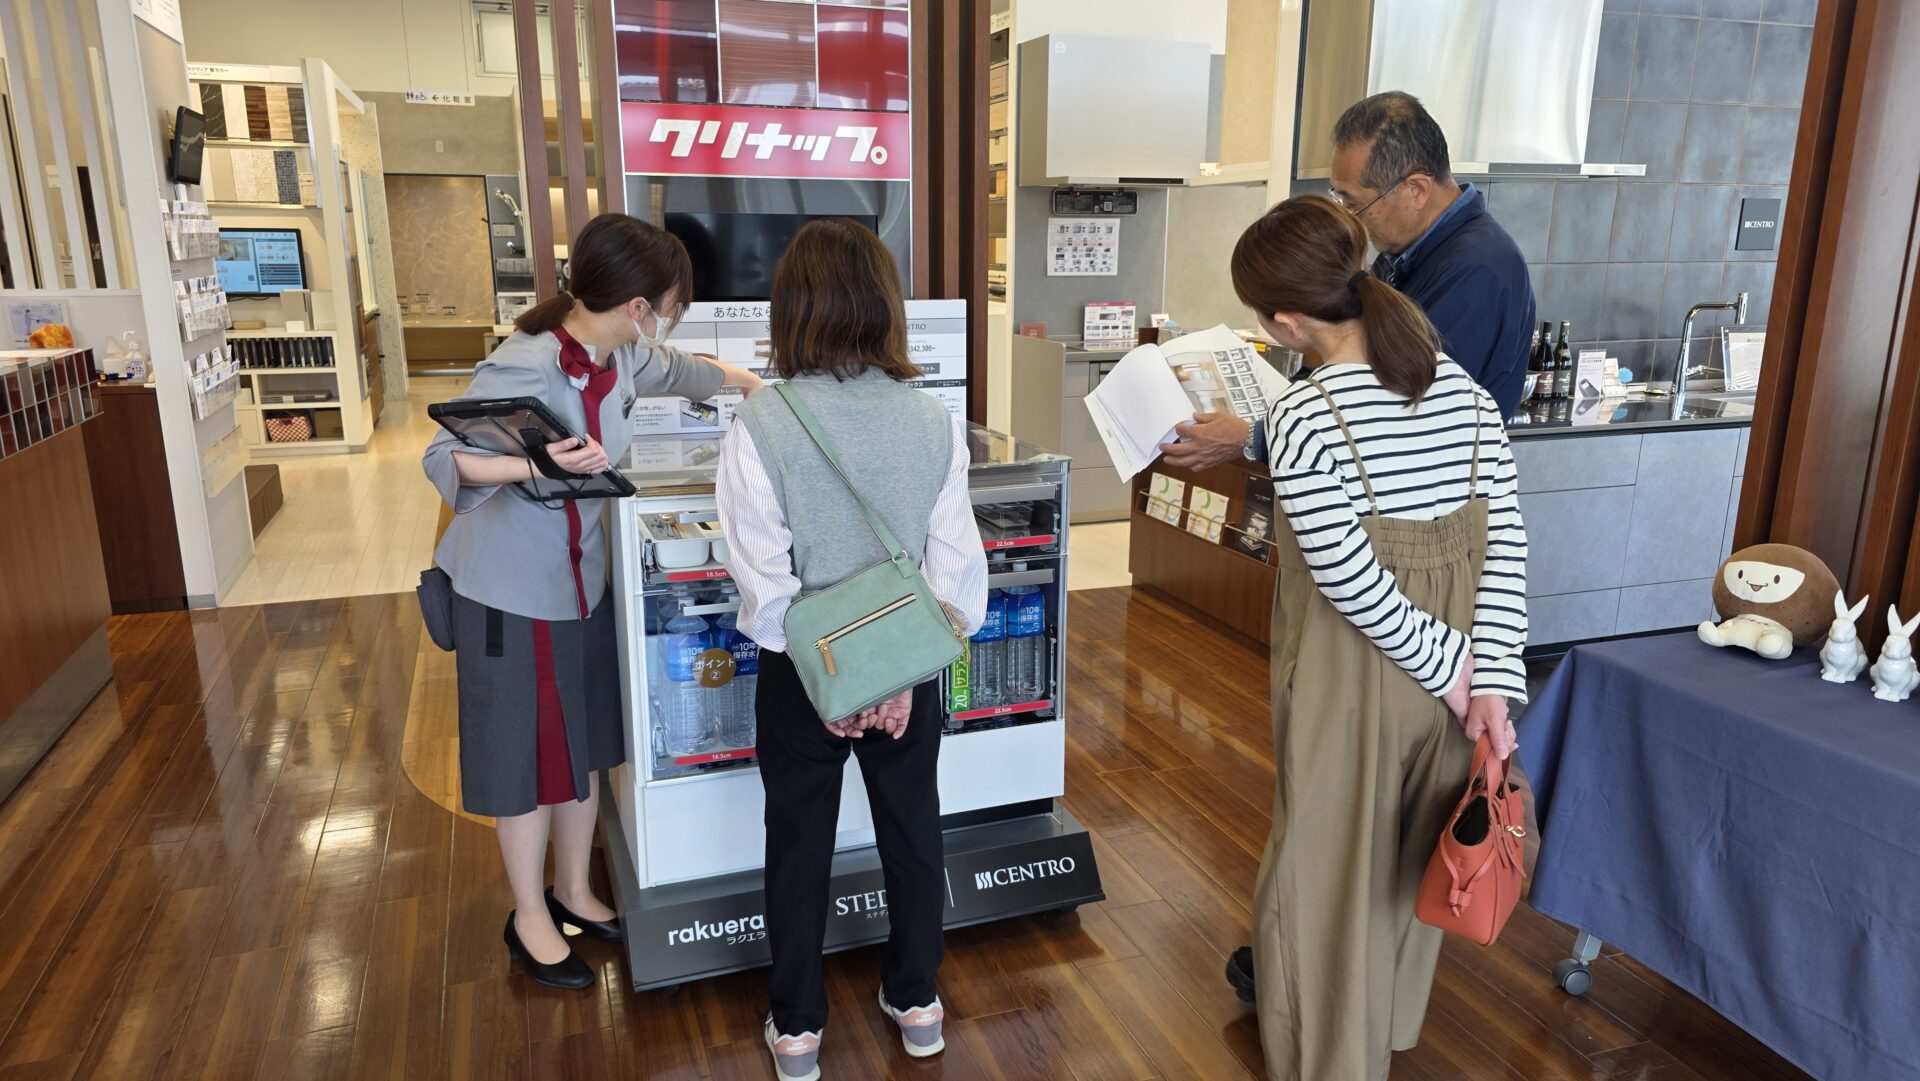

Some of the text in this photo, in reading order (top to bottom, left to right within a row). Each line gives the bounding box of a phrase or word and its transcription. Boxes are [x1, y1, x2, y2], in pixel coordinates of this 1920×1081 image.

[1750, 220, 1774, 228] CENTRO
[739, 642, 757, 651] 10年
[733, 651, 756, 659] 保存水
[694, 657, 735, 669] ポイント
[711, 752, 732, 760] 18.5cm
[993, 856, 1076, 886] CENTRO
[668, 914, 765, 946] rakuera
[726, 930, 767, 946] ラクエラ
